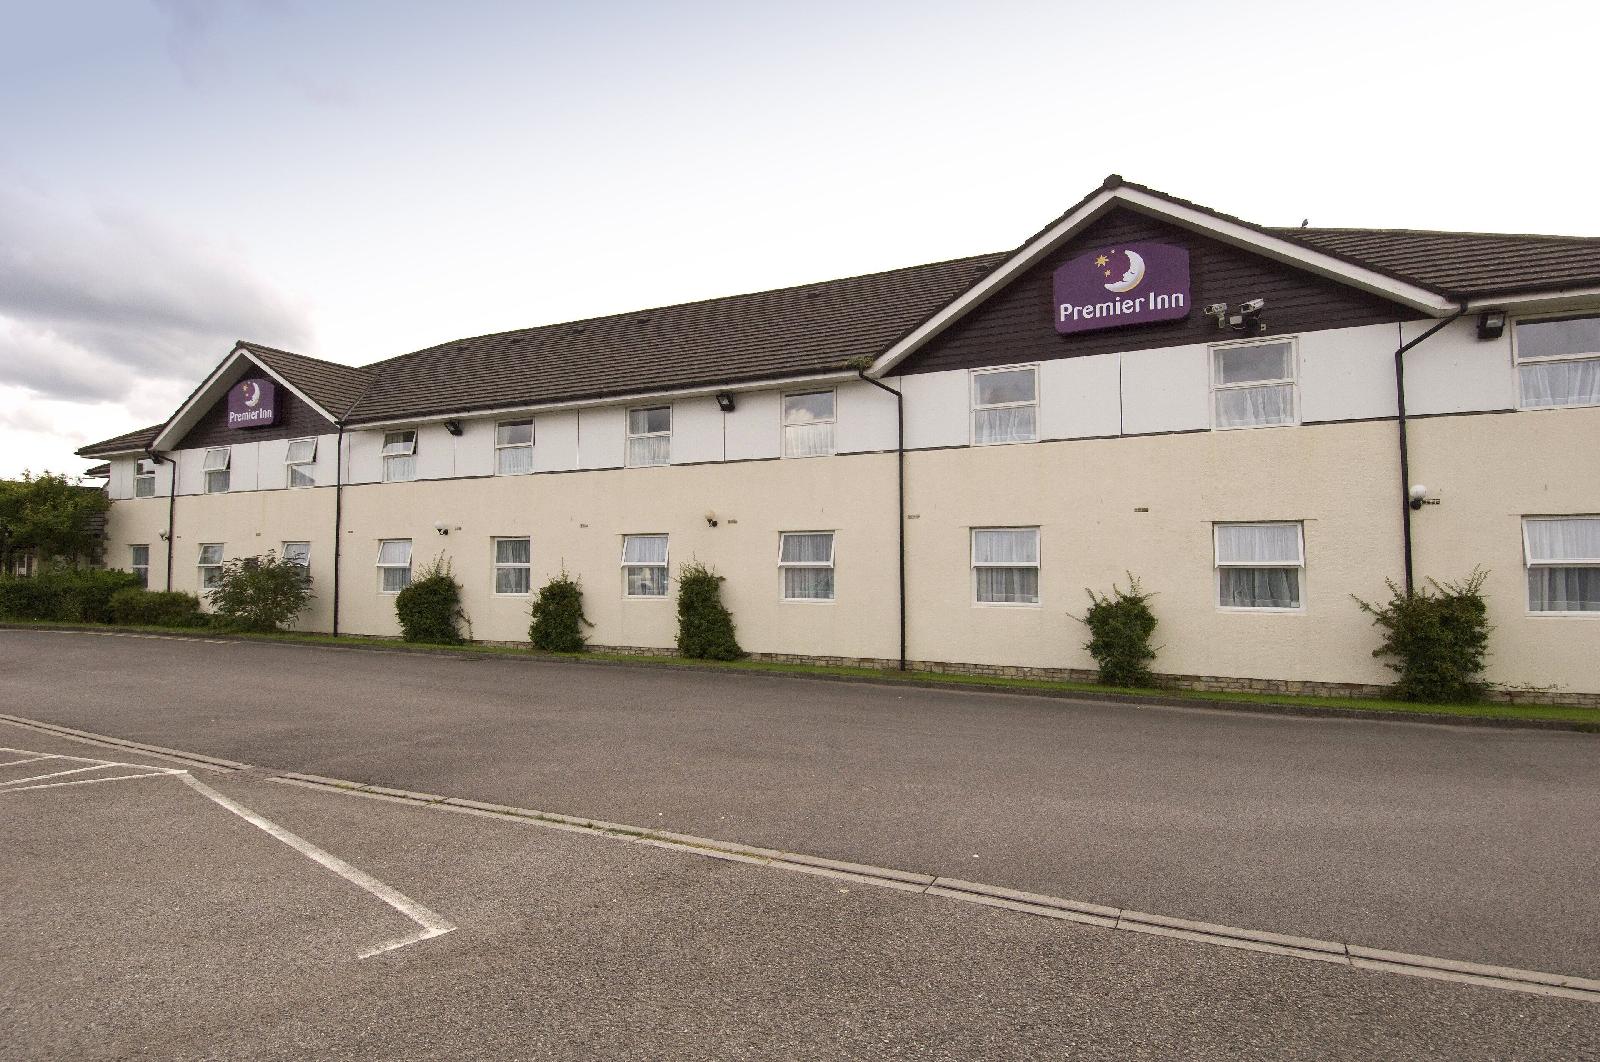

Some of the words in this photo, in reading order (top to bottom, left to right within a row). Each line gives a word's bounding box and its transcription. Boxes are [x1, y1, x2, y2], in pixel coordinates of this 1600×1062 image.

[1060, 297, 1145, 322] Premier
[1150, 292, 1184, 310] Inn
[230, 409, 259, 422] Premier
[260, 408, 272, 419] Inn
